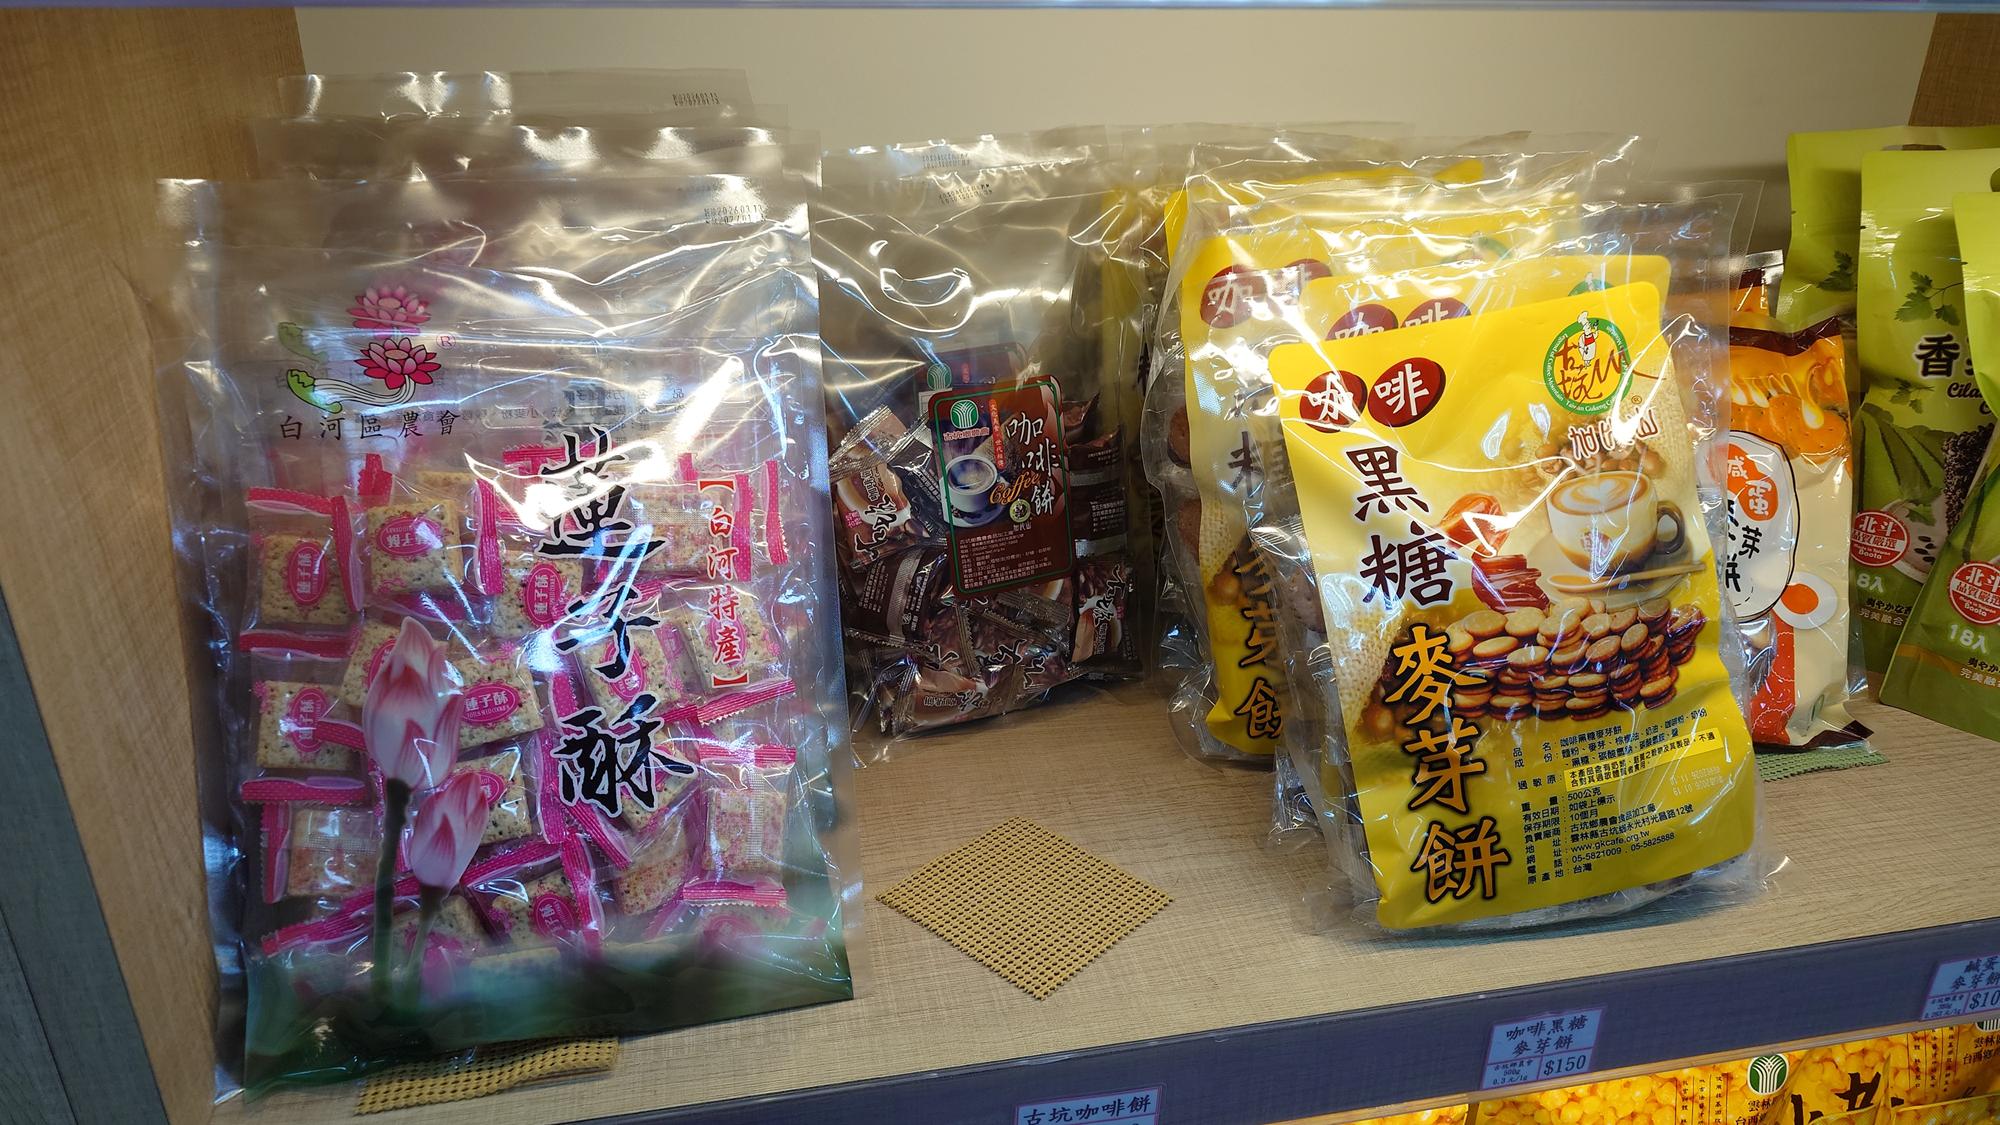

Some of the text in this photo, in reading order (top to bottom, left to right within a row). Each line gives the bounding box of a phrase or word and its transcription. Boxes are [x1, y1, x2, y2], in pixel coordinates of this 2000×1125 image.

[1914, 333, 1974, 378] 香
[1307, 362, 1430, 421] 咖啡
[280, 410, 460, 440] 白河區農會
[1006, 411, 1060, 517] 咖啡餅
[989, 470, 1042, 506] Coffee
[1859, 515, 1897, 537] 北斗
[1965, 567, 2000, 593] 北斗
[535, 424, 695, 817] 蓮子酥
[1859, 606, 1904, 626] 完美融合
[1950, 623, 1987, 654] 18入
[1968, 656, 2000, 673] 爽やか
[465, 691, 508, 712] 蓮子酥
[1384, 623, 1511, 903] 麥芽餅
[1567, 786, 1602, 802] 500公克
[1568, 793, 1616, 812] 如袋上標示
[1569, 808, 1599, 822] 10個月
[1570, 802, 1657, 833] 古坑鄉農會食品加工廠
[1571, 830, 1650, 853] www.gkcafe.org.tw
[1573, 863, 1593, 875] 台灣
[1506, 1014, 1588, 1041] 咖啡黑糖
[1512, 1034, 1574, 1058] 麥芽餅
[1543, 1054, 1587, 1077] $150
[1023, 1094, 1152, 1125] 古坑咖啡餅
